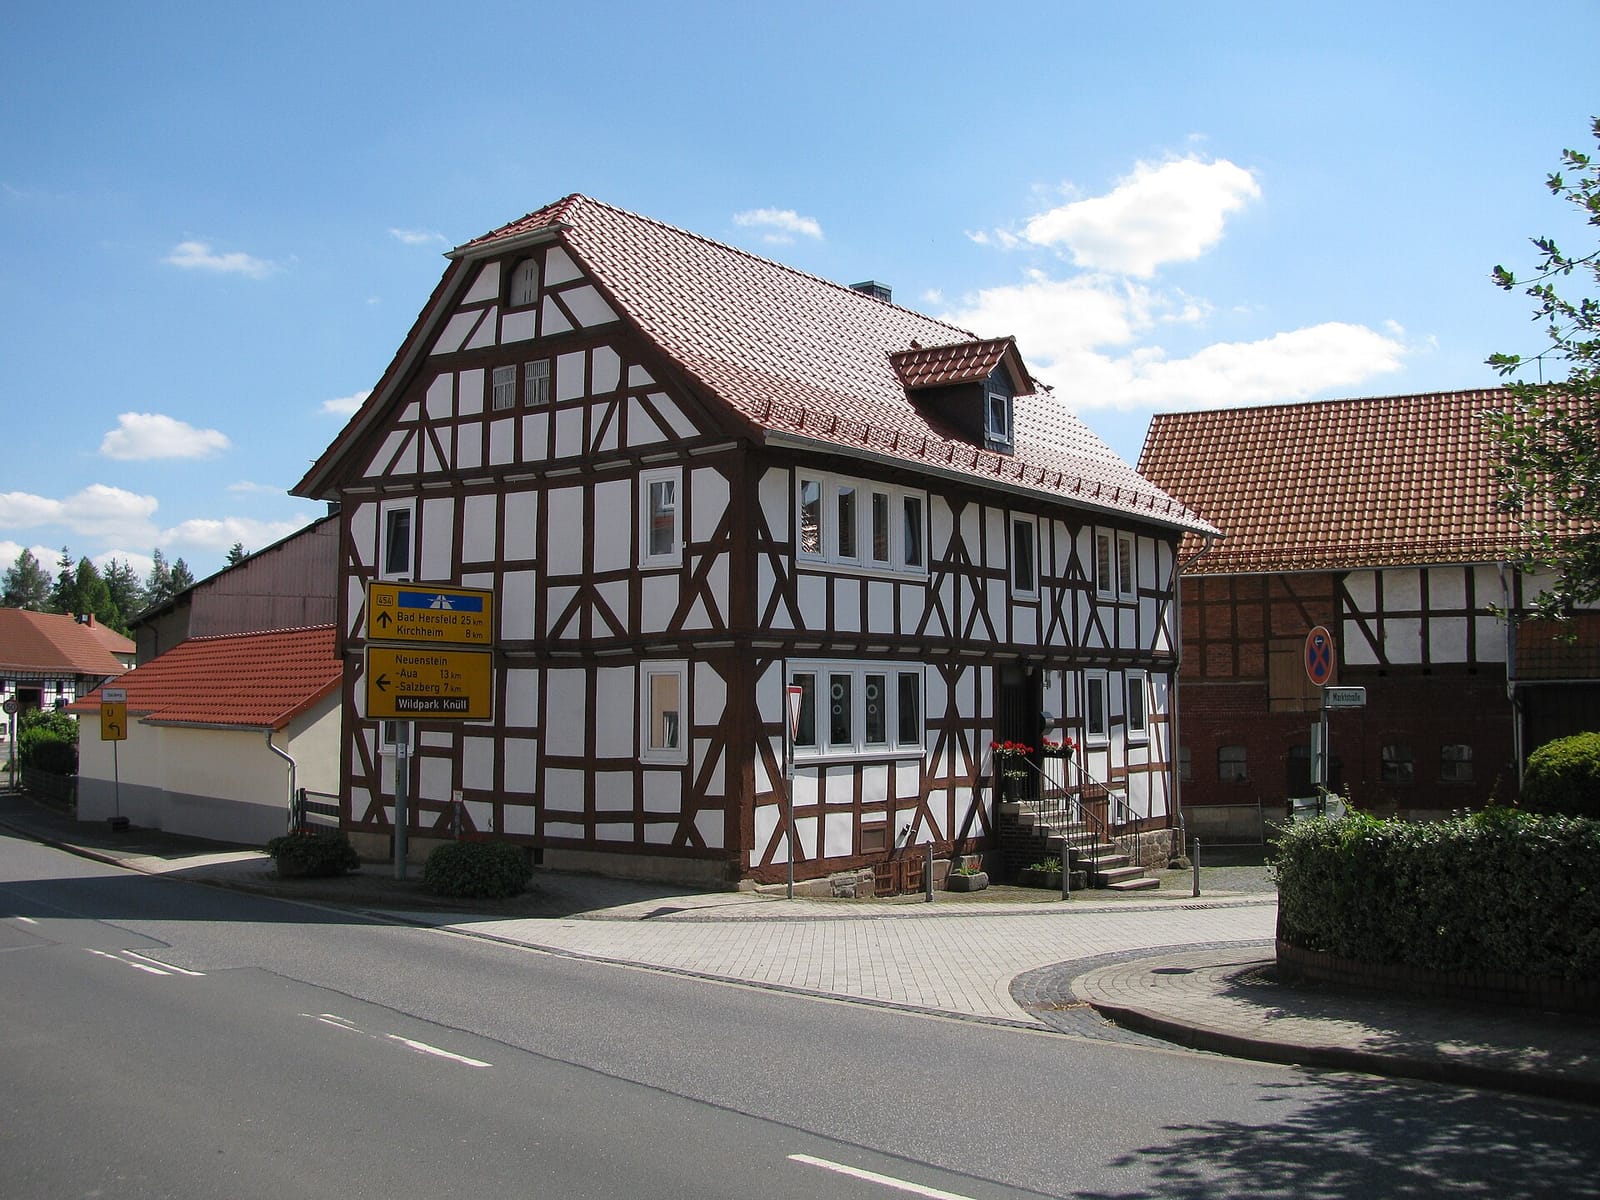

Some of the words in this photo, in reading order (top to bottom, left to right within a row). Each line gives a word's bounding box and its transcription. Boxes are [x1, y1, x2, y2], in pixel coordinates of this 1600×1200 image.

[378, 595, 392, 605] 454
[397, 612, 415, 622] Bad
[418, 614, 457, 625] Hersfeld
[460, 615, 471, 625] 25
[472, 617, 483, 625] km
[397, 625, 443, 637] Kirchheim
[465, 630, 471, 638] 8
[472, 631, 483, 639] km
[395, 654, 448, 665] Neuenstein
[440, 669, 449, 679] 13
[450, 671, 461, 679] km
[444, 683, 449, 692] 7
[450, 685, 461, 693] km
[398, 698, 439, 711] Wildpark
[443, 700, 467, 710] Knüll
